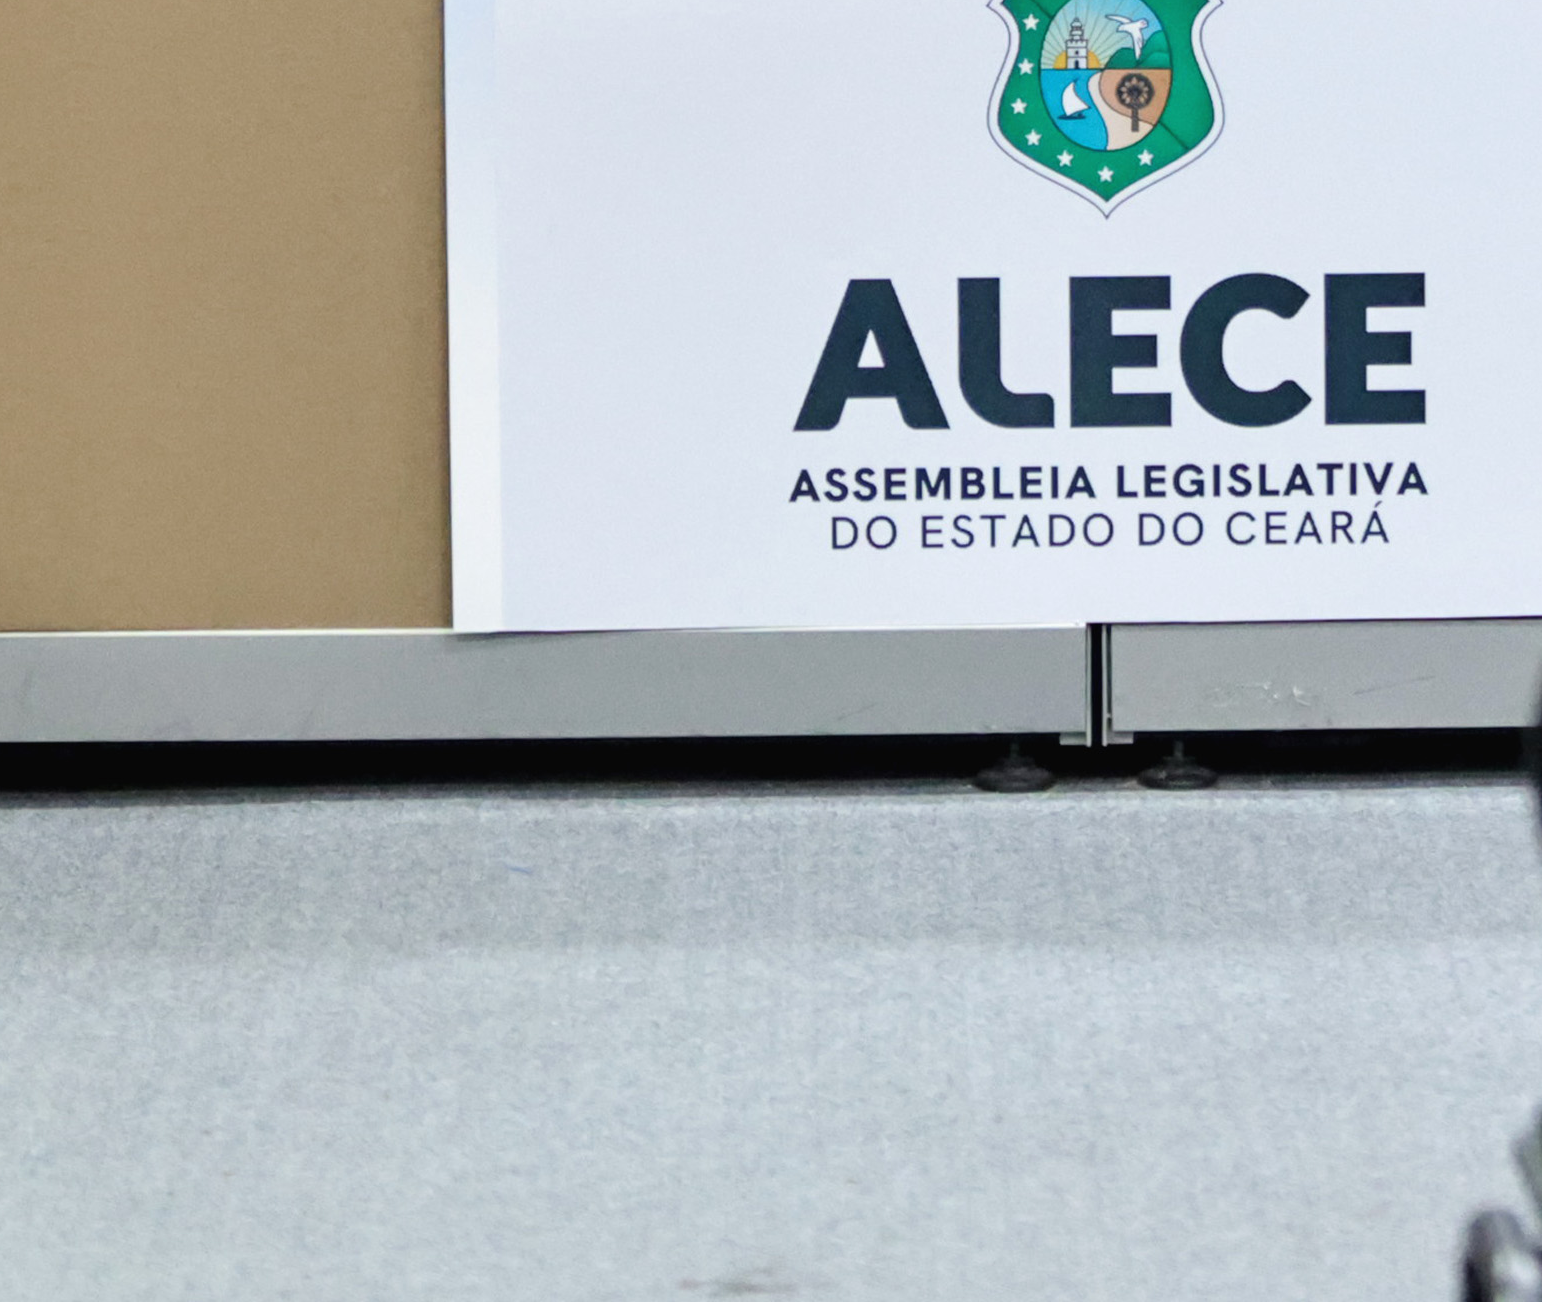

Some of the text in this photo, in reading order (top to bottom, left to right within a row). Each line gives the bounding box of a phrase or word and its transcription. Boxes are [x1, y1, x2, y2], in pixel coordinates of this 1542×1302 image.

[793, 272, 1427, 431] ALECE
[789, 462, 1428, 502] ASSEMBLEIA LEGISLATIVA
[832, 501, 1390, 550] DO ESTADO DO CEARÁ
